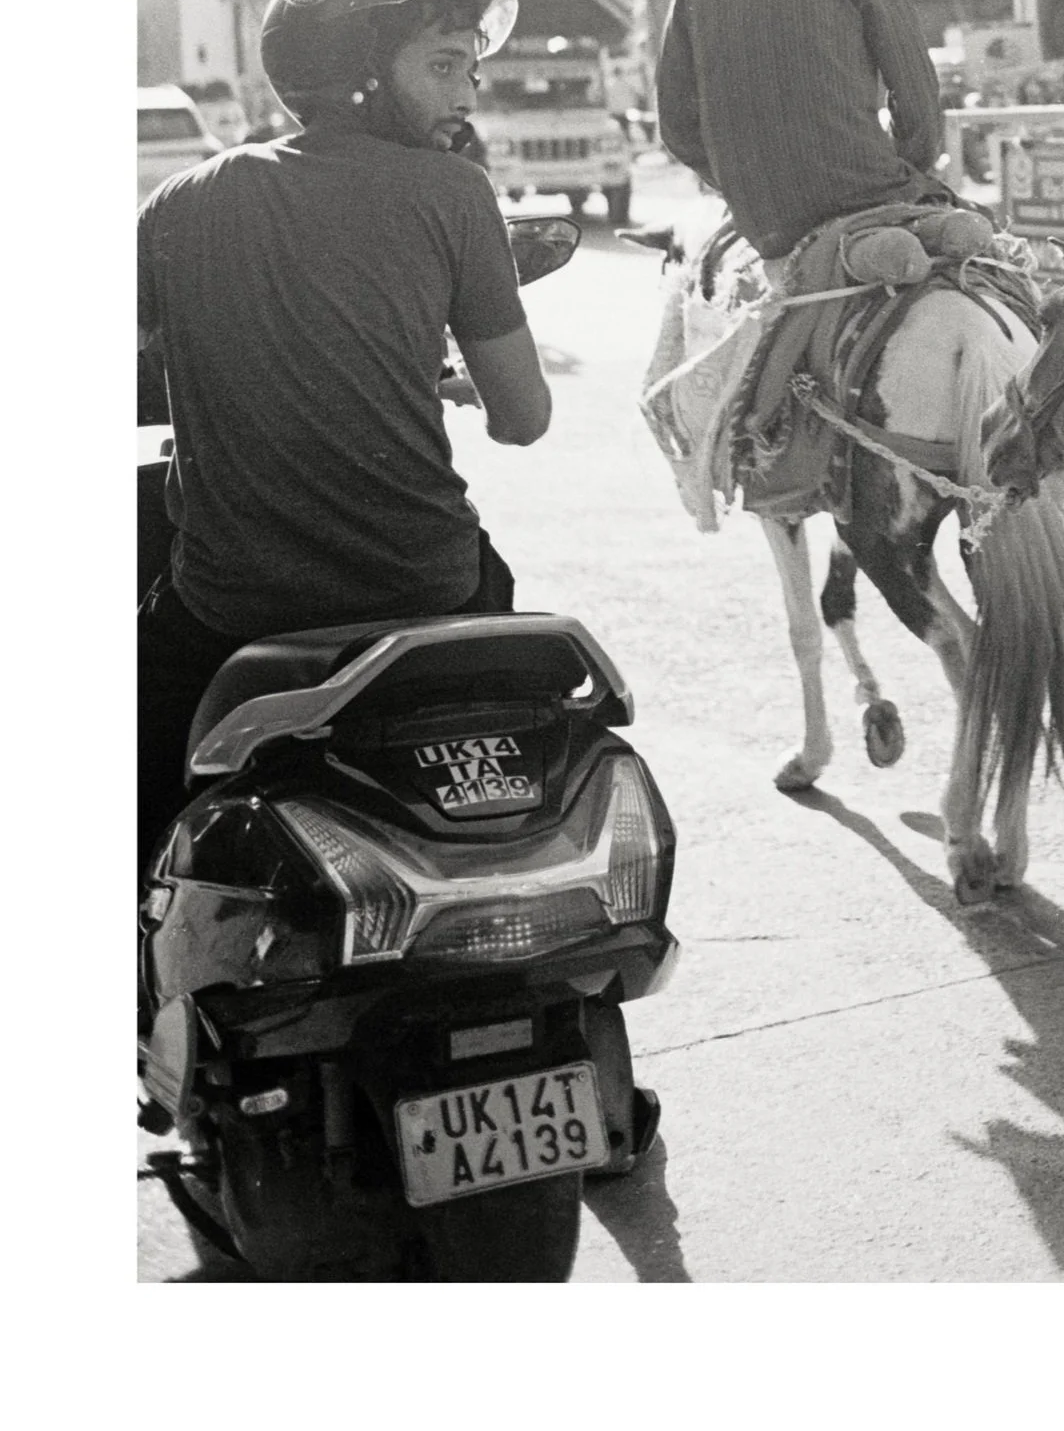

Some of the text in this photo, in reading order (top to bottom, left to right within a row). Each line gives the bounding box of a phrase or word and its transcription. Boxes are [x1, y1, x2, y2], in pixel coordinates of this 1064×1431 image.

[418, 737, 517, 765] UK14
[447, 758, 502, 781] TA
[443, 777, 531, 804] 4139
[440, 1072, 576, 1139] UK14T
[453, 1118, 588, 1187] A4139
